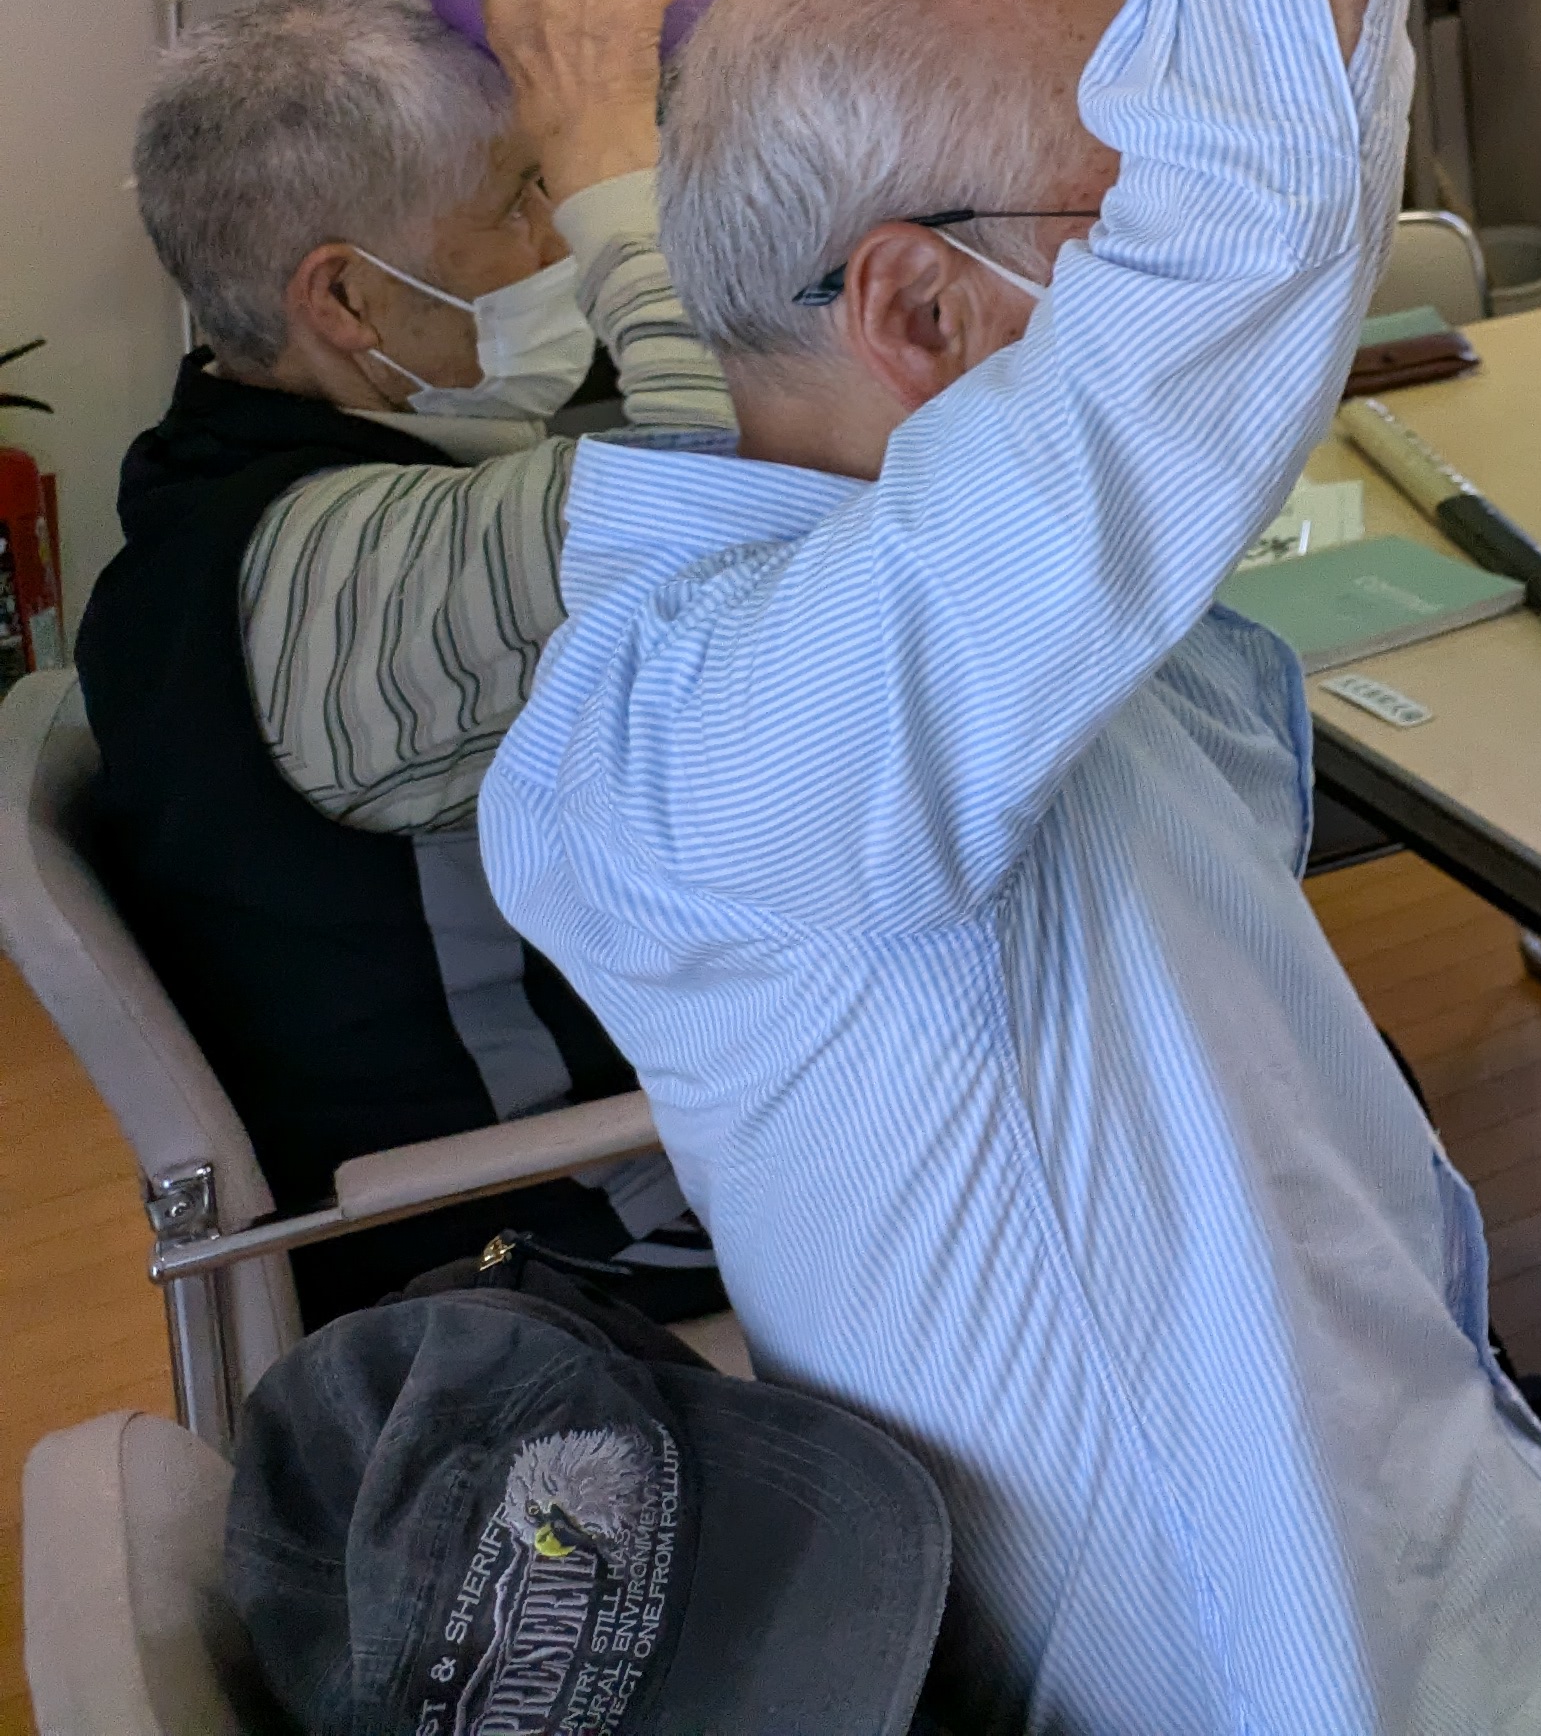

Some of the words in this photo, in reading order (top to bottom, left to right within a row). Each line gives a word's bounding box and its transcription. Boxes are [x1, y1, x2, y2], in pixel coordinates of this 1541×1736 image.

[606, 1527, 631, 1581] HAS
[591, 1587, 622, 1654] STILL
[634, 1602, 663, 1658] ONE
[649, 1533, 675, 1598] FROM
[430, 1656, 457, 1683] &
[556, 1662, 598, 1736] NTRY
[576, 1659, 624, 1736] URAL
